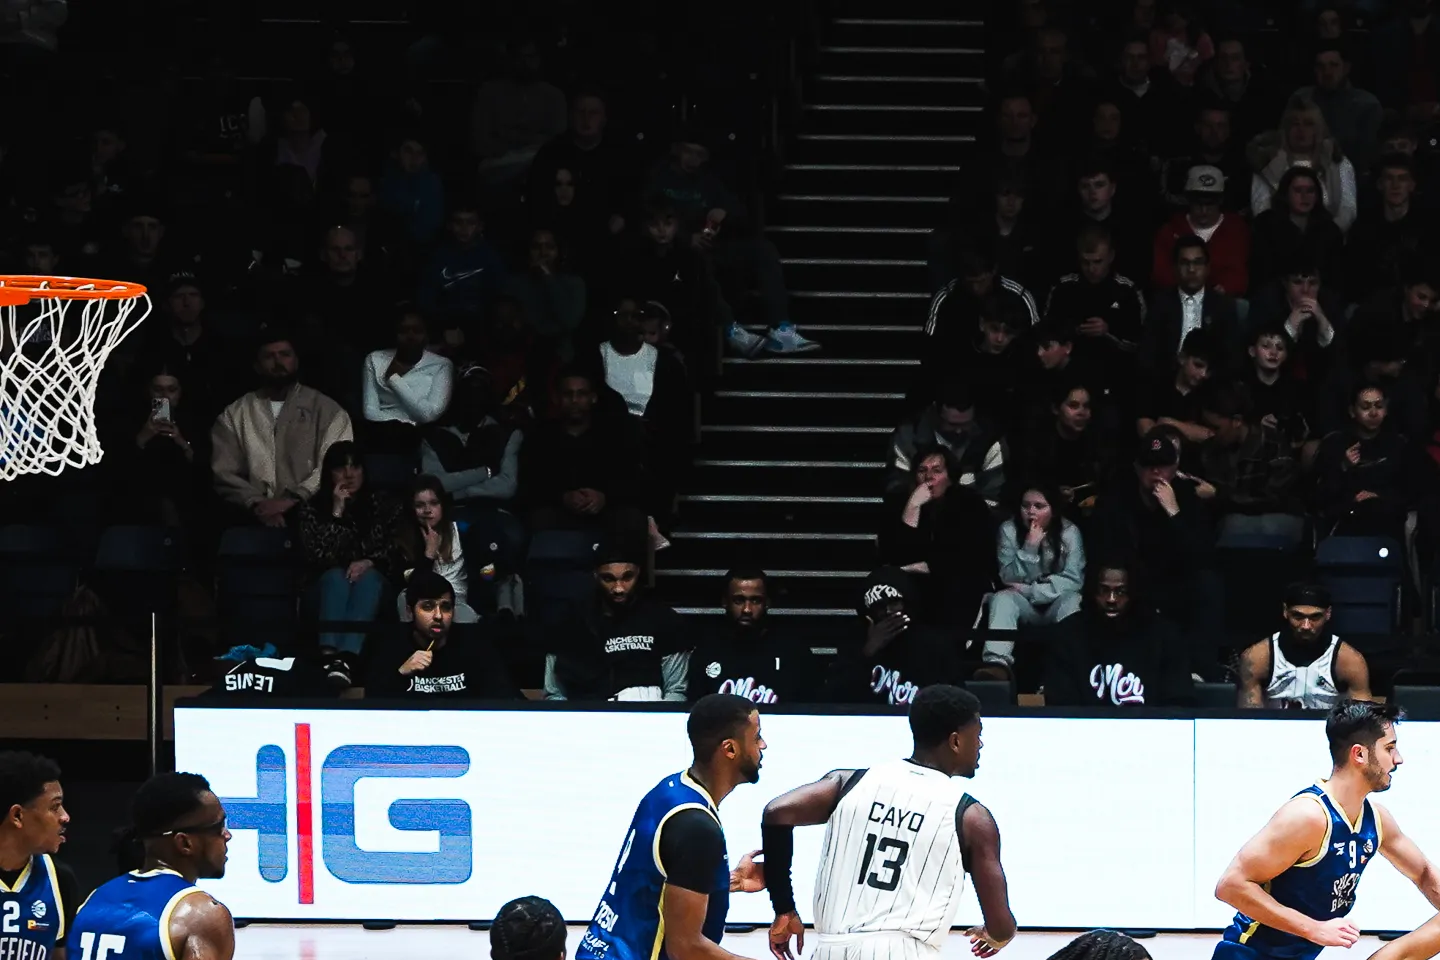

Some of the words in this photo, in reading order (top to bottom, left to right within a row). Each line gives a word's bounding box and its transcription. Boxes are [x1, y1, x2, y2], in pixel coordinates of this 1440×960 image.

[225, 672, 274, 693] LEWIS
[868, 801, 925, 833] CAYO
[857, 833, 910, 892] 13
[1348, 840, 1357, 869] 9
[2, 900, 20, 933] 2
